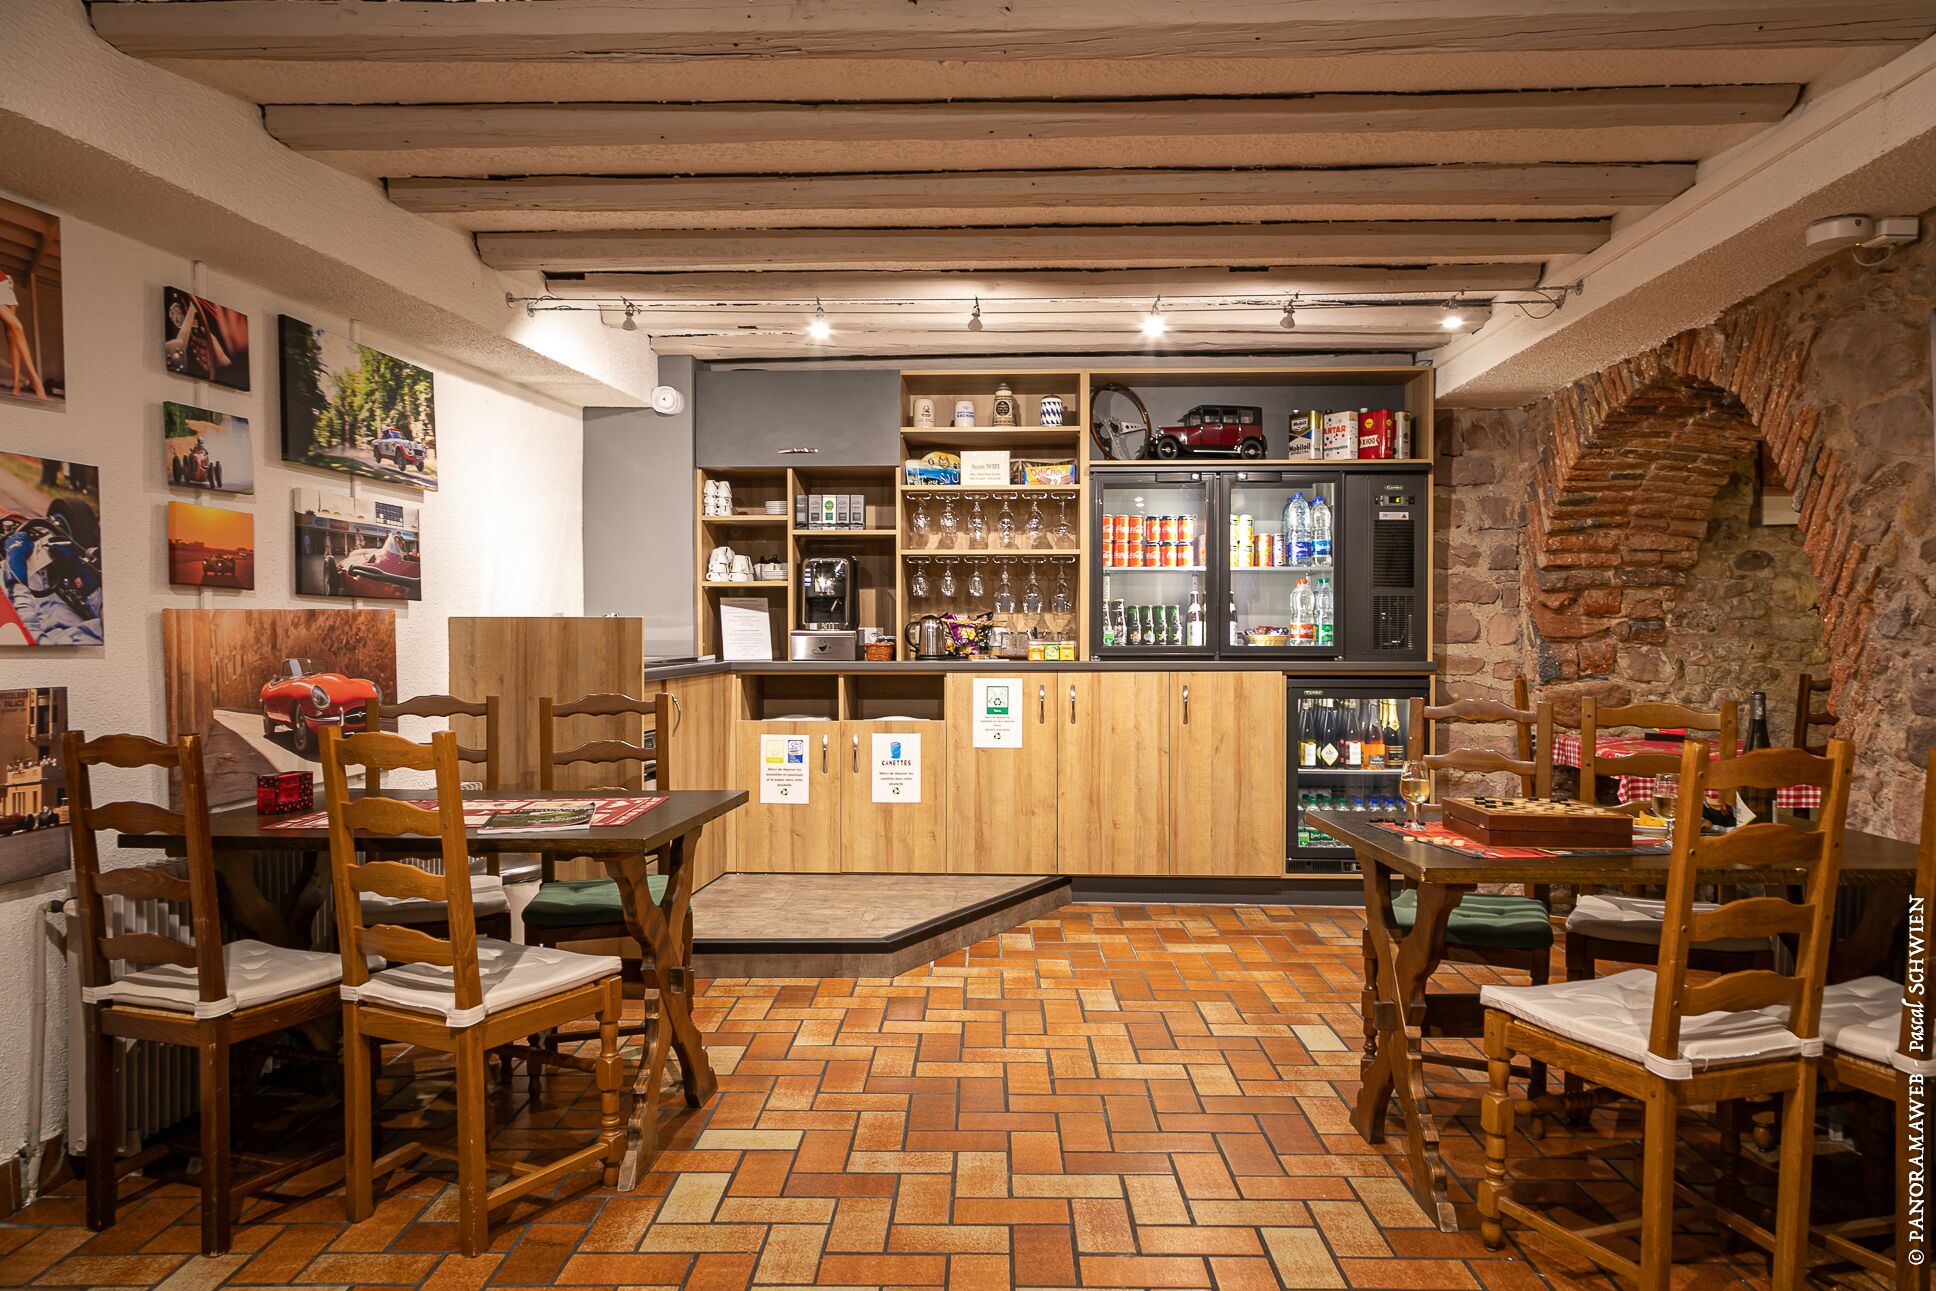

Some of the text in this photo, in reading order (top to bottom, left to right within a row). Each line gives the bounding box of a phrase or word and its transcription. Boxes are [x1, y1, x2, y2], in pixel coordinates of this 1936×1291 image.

[1324, 425, 1347, 435] ANTAR
[1289, 442, 1311, 453] Mobiloil
[881, 759, 912, 767] CANETTES
